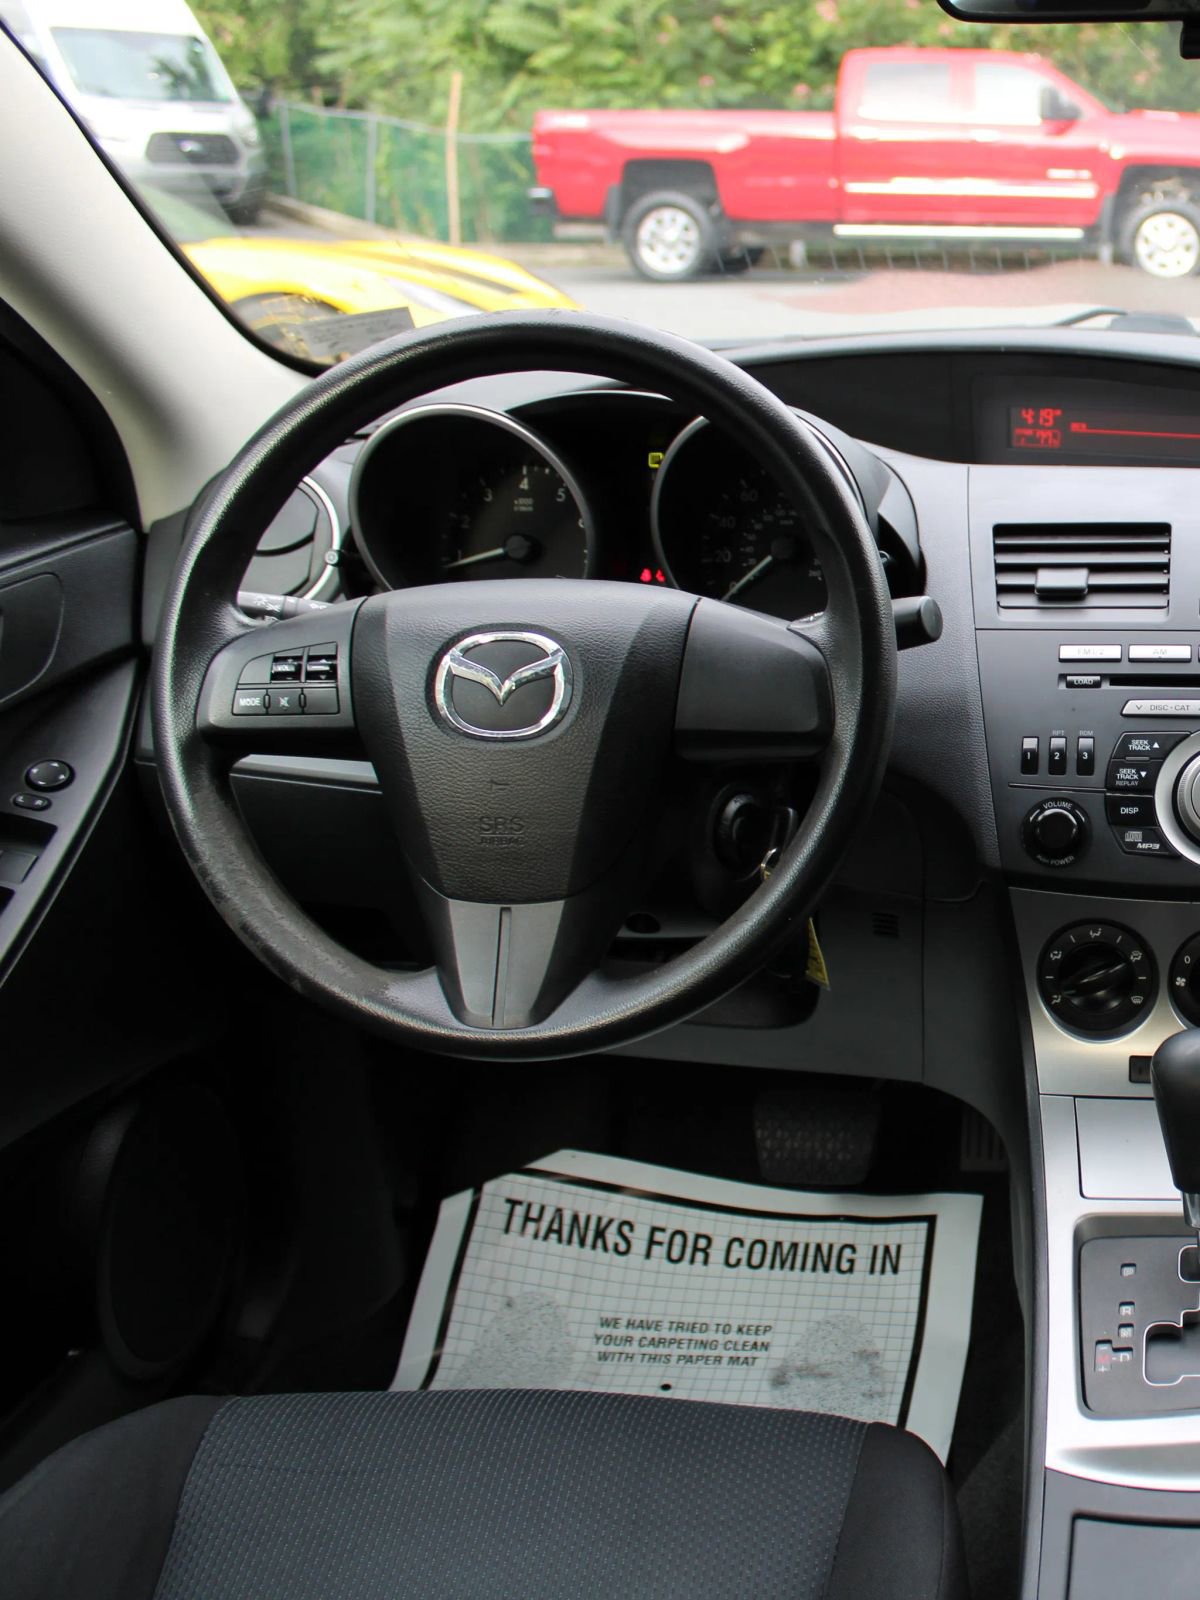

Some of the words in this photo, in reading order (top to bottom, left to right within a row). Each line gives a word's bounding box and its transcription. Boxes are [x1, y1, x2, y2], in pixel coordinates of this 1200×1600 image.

[519, 477, 529, 490] 4
[482, 488, 493, 502] 3
[555, 488, 566, 502] 5
[1152, 648, 1168, 656] AM
[1073, 678, 1094, 686] LOAD
[239, 697, 262, 707] MODE
[1053, 752, 1060, 760] 2
[1082, 752, 1089, 760] 3
[1042, 801, 1073, 810] VOLUME
[1183, 955, 1191, 965] 0
[503, 1198, 634, 1256] THANKS
[644, 1225, 713, 1266] FOR
[724, 1236, 857, 1275] COMING
[869, 1243, 902, 1275] IN
[599, 1317, 622, 1330] WE
[625, 1319, 664, 1332] HAVE
[667, 1321, 709, 1334] TRIED
[714, 1323, 732, 1335] TO
[736, 1325, 773, 1337] KEEP
[594, 1334, 634, 1347] YOUR
[638, 1336, 719, 1351] CARPETING
[723, 1340, 771, 1353] CLEAN
[597, 1351, 634, 1363] WITH
[639, 1353, 672, 1365] THIS
[675, 1354, 723, 1366] PAPER
[726, 1356, 760, 1368] MAT
